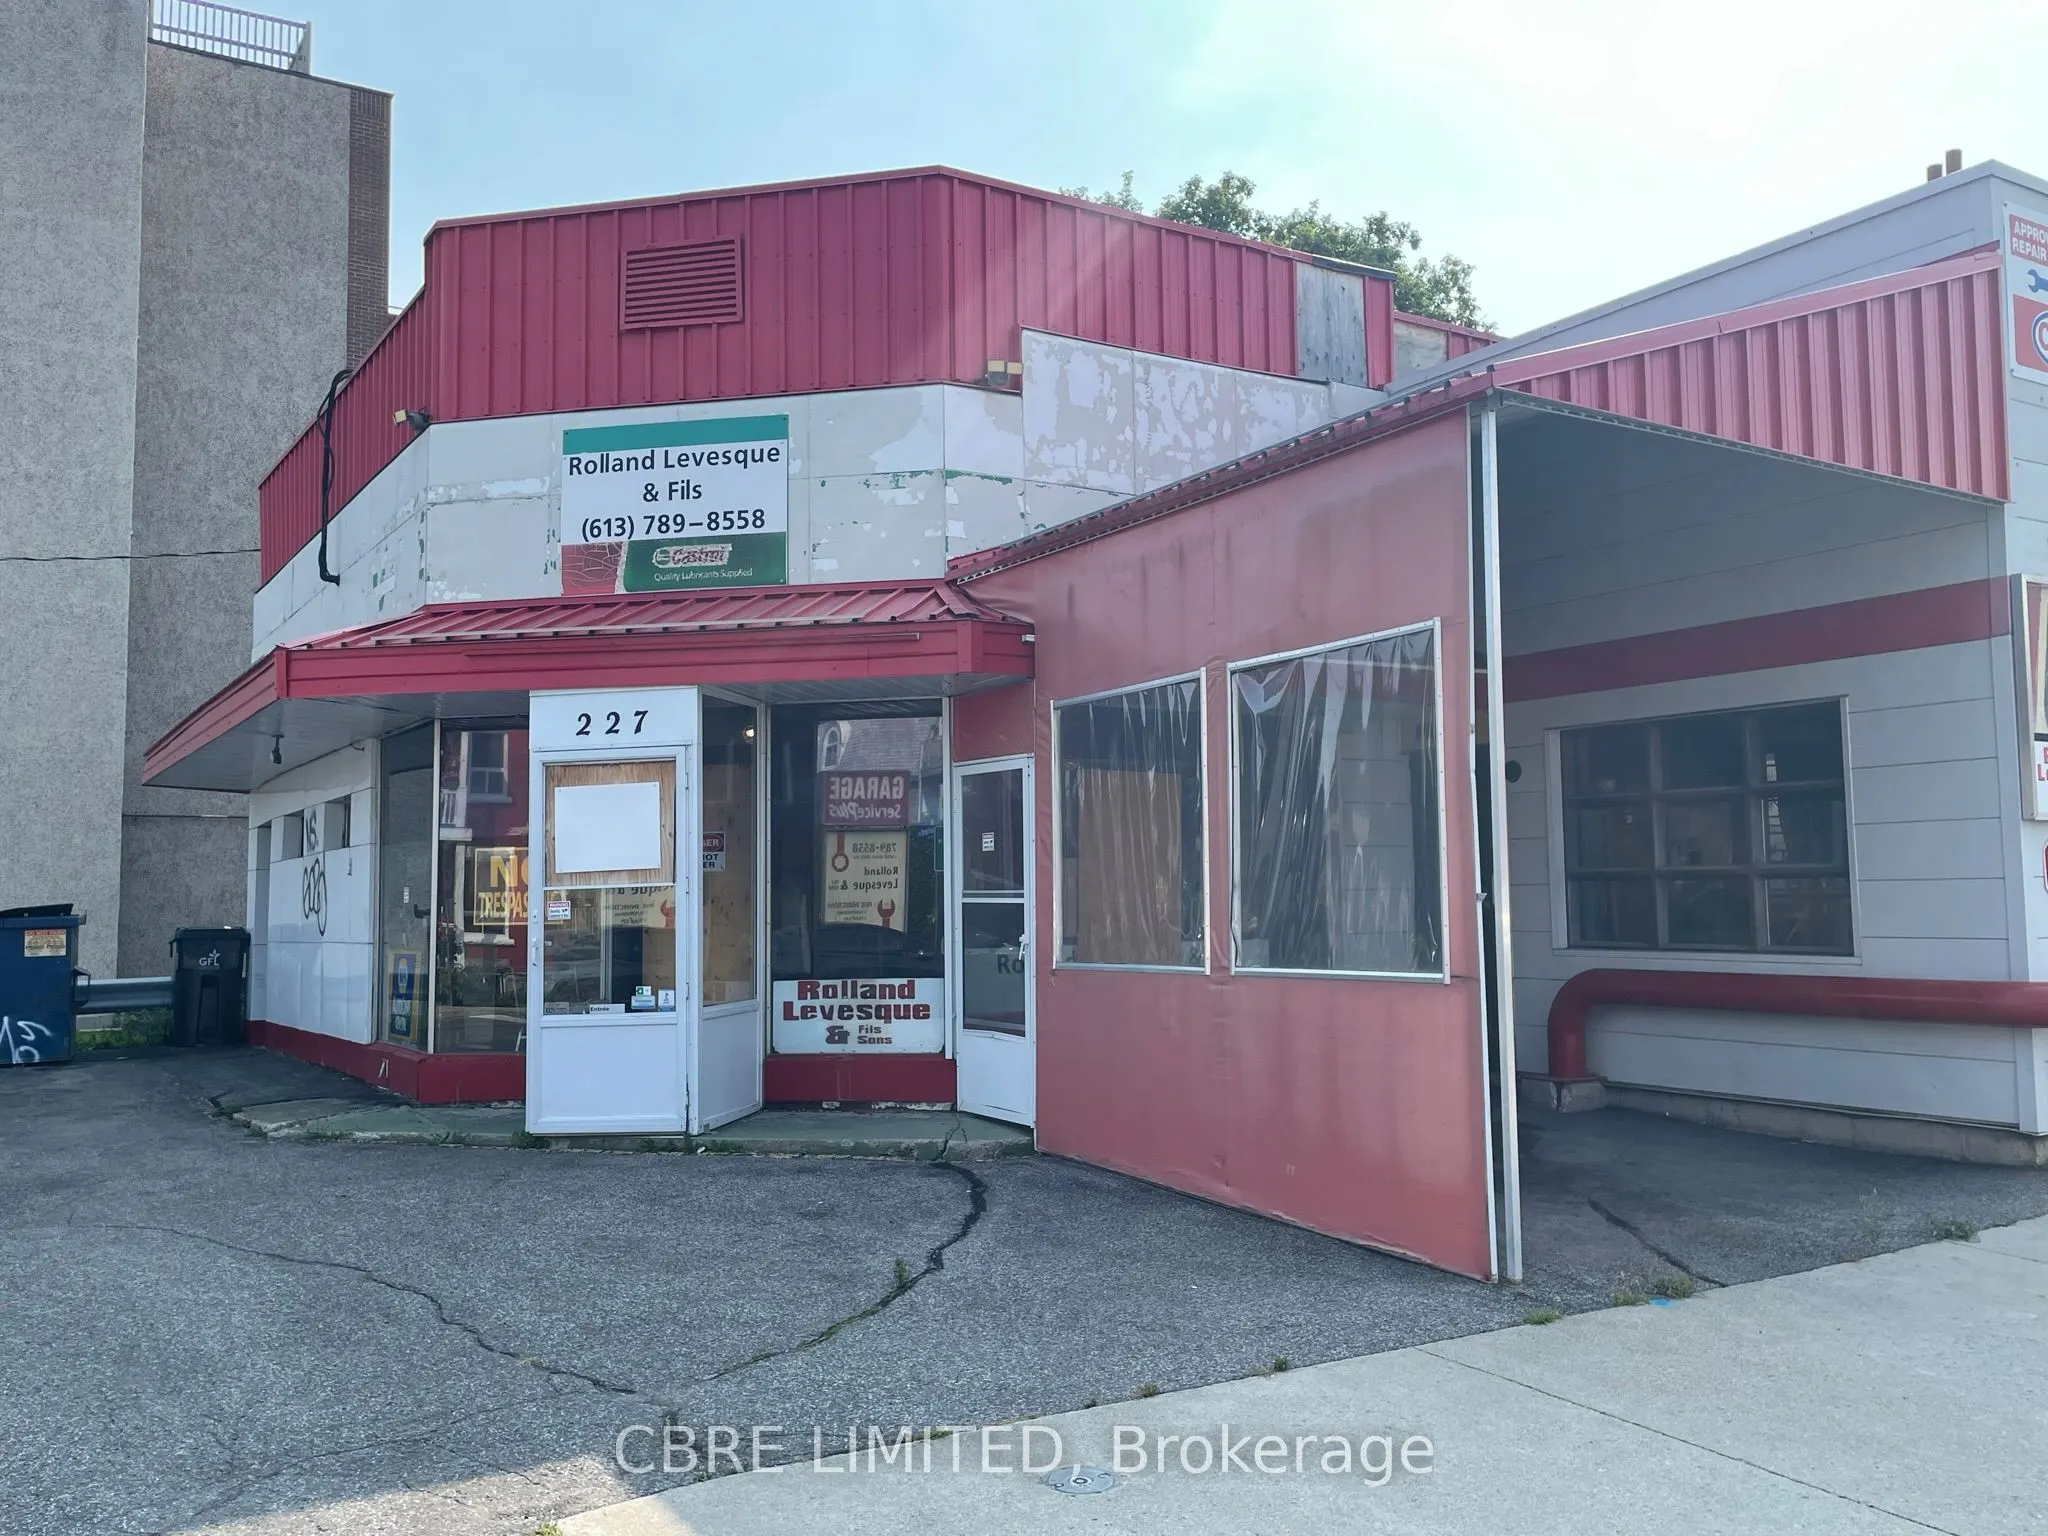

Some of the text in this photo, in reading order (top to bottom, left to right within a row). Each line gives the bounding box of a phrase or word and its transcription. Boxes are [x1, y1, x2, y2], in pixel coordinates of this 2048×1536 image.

[2013, 221, 2048, 245] APPRO
[2012, 236, 2047, 262] REPAIR
[569, 446, 781, 476] Rolland Levesque
[642, 479, 703, 503] & Fils
[582, 508, 766, 542] (613) 789-8558
[653, 568, 753, 582] Quality Lubricants Supplied
[575, 710, 649, 736] 227
[199, 955, 221, 966] GFL
[797, 979, 916, 1001] Rolland
[783, 1001, 931, 1024] Levesque
[825, 1024, 882, 1045] & Fils
[857, 1035, 893, 1045] Sons
